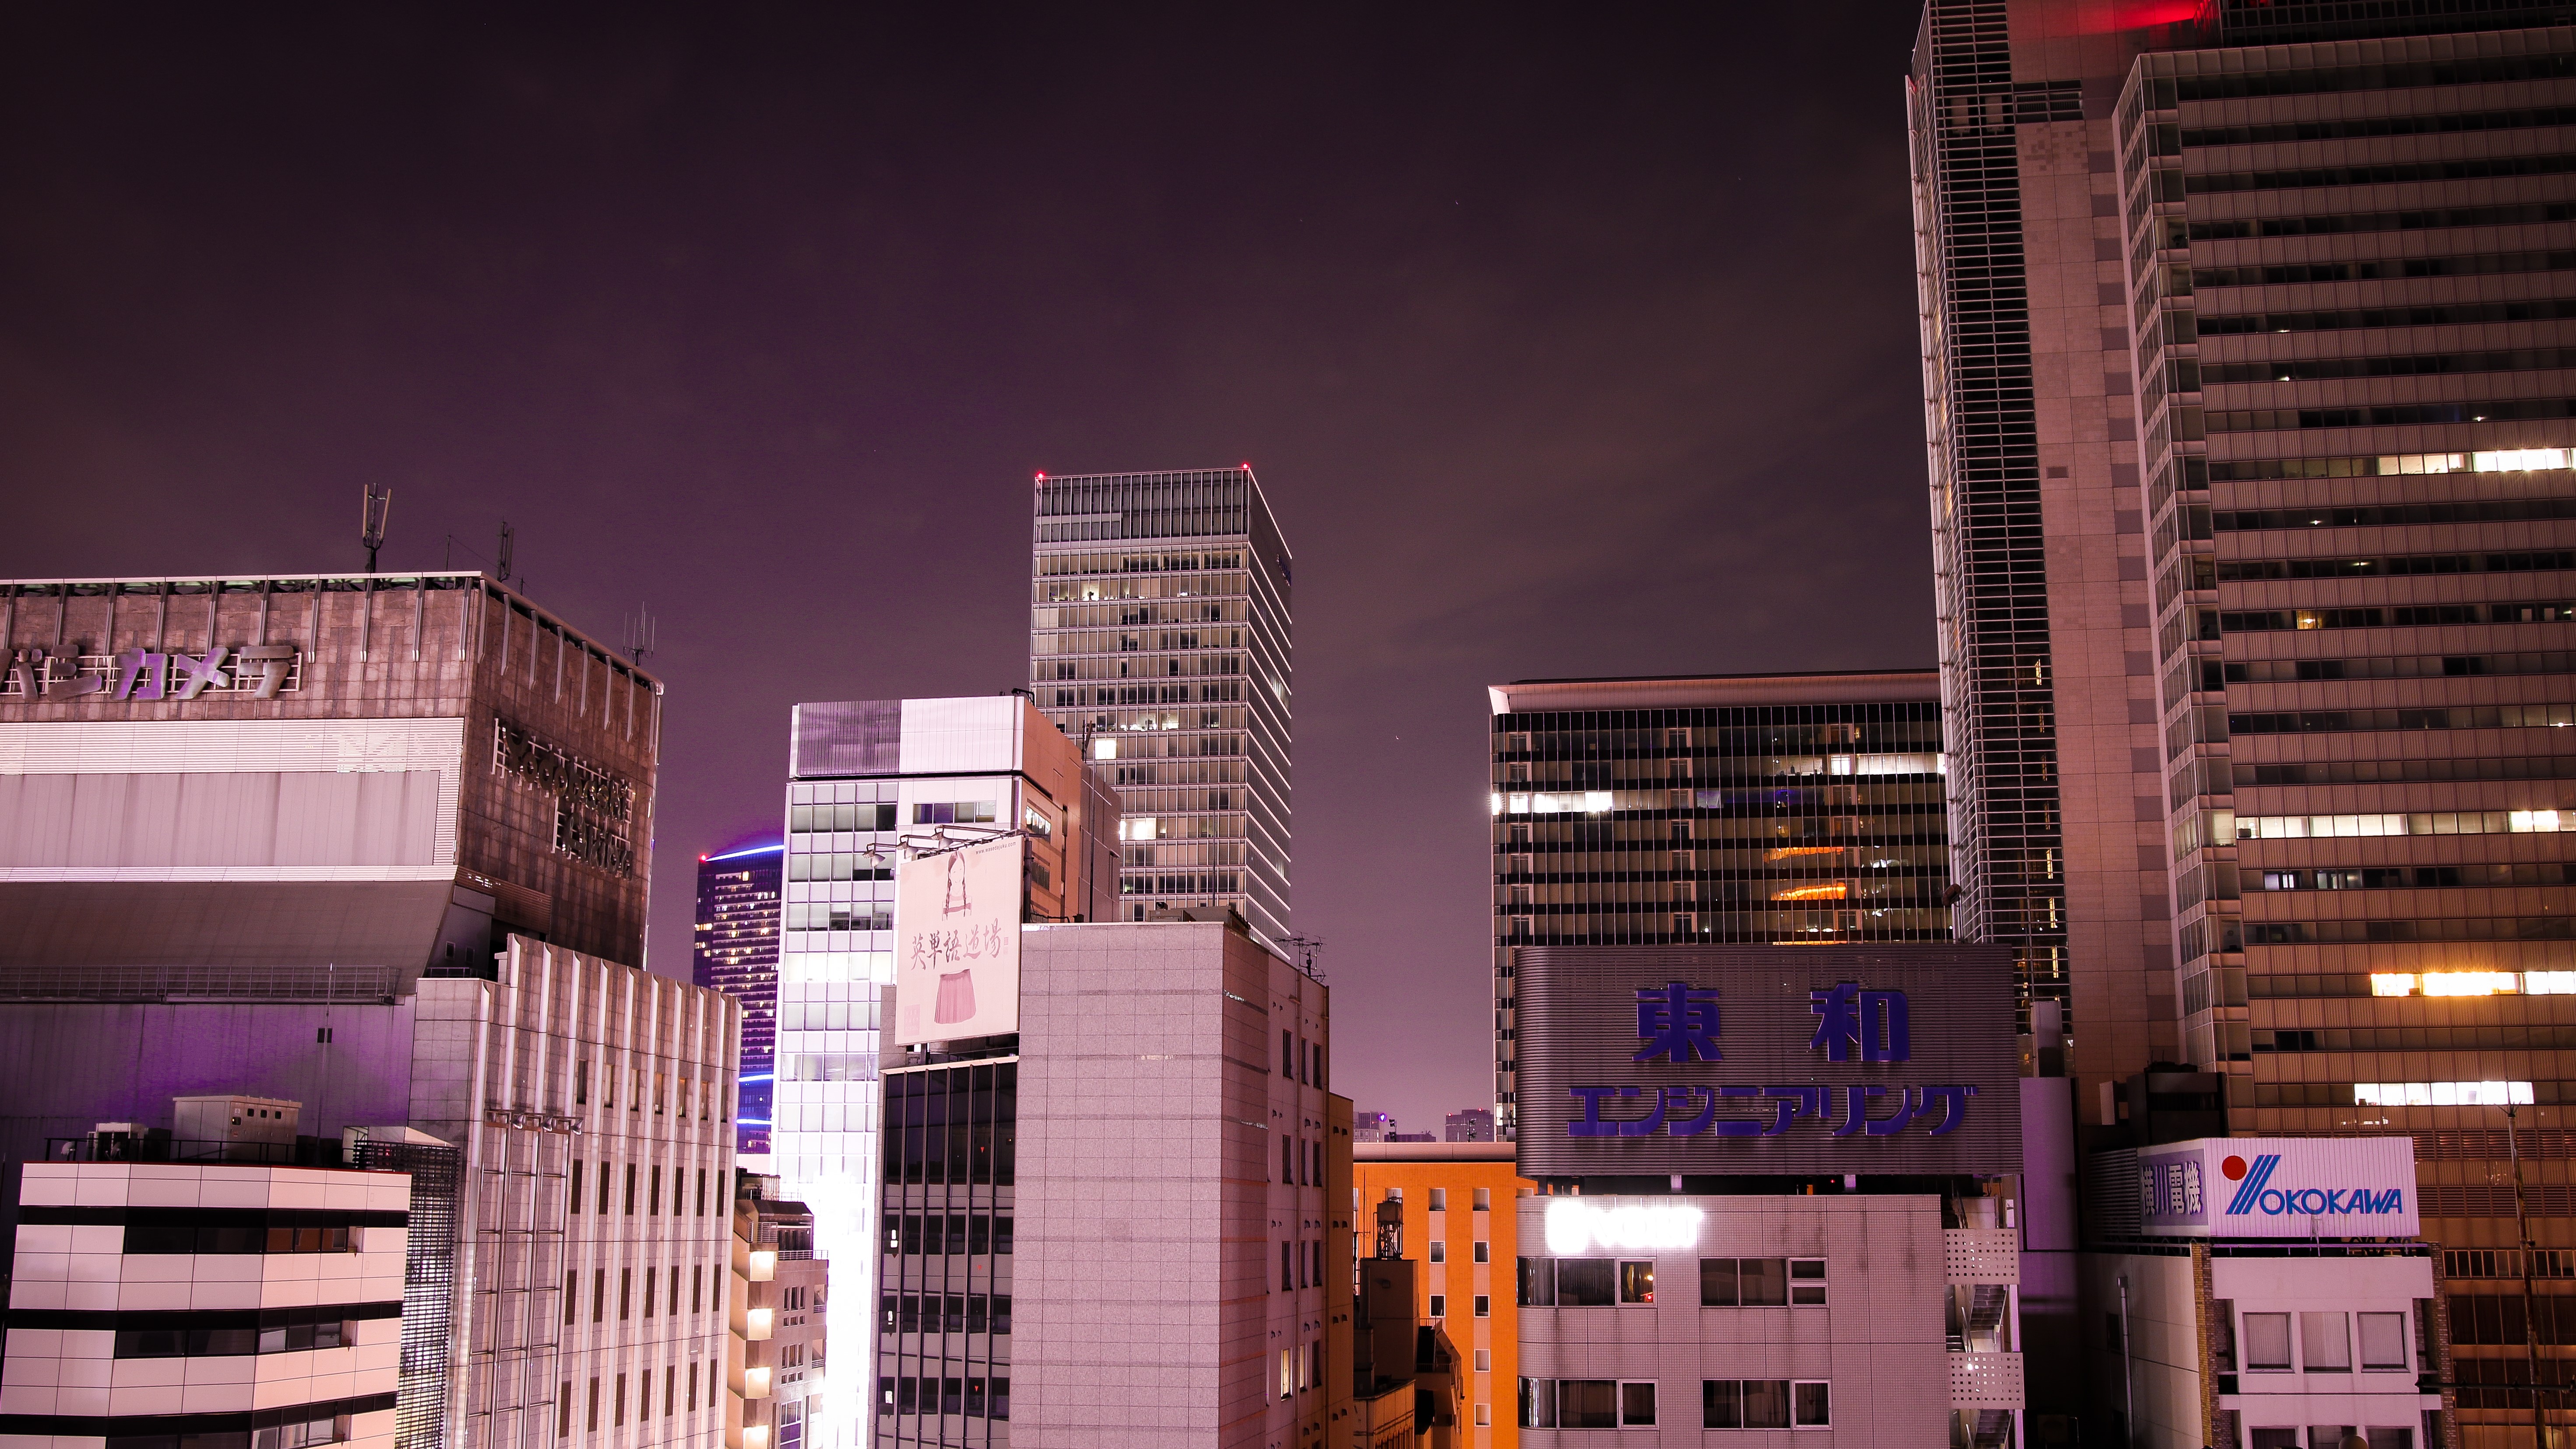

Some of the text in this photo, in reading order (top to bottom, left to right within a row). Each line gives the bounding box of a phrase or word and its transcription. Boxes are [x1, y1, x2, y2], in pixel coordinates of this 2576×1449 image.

[910, 918, 1002, 971] 英単語道場
[1568, 1086, 1978, 1136] エンジニアリング
[2141, 1161, 2202, 1215] 横川電機
